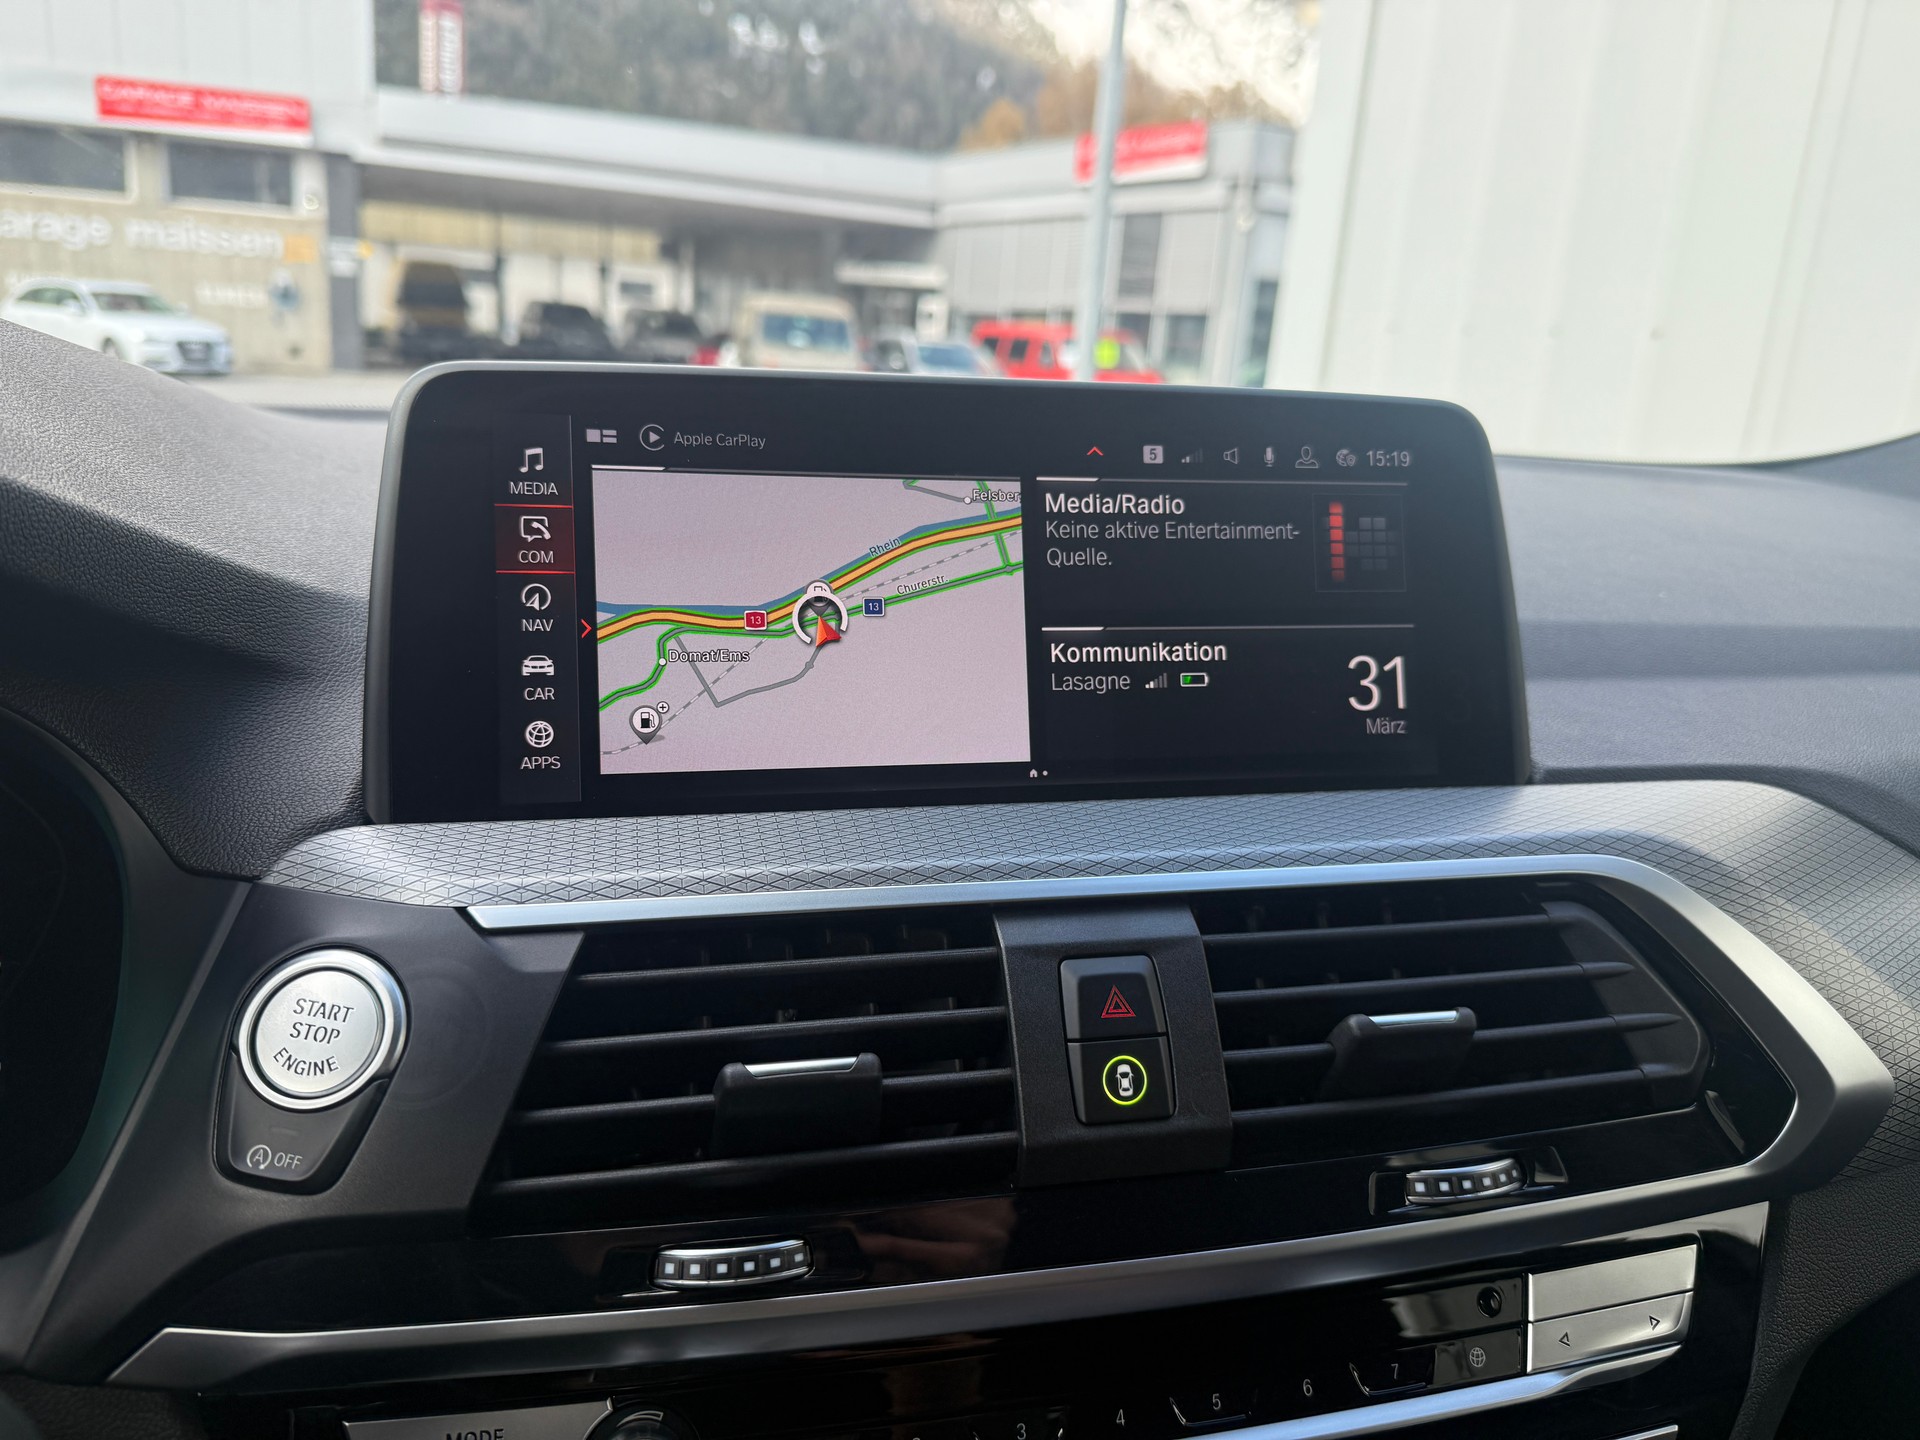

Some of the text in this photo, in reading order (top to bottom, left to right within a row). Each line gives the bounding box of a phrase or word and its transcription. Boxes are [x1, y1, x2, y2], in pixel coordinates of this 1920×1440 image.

[673, 431, 766, 450] Apple CarPlay
[1148, 447, 1158, 462] 5
[1366, 449, 1411, 468] 15:19
[509, 481, 559, 496] MEDIA
[972, 488, 1021, 503] Felsber
[1044, 492, 1186, 516] Media/Radio
[1044, 520, 1301, 541] Keine aktive Entertainment-
[869, 537, 901, 556] Rhein
[518, 550, 555, 565] COM
[1045, 547, 1114, 567] Quelle.
[896, 574, 948, 594] Churerstr.
[867, 601, 880, 612] 13
[521, 618, 554, 633] NAV
[749, 614, 762, 626] 13
[668, 648, 751, 664] Domat/Ems
[1049, 641, 1228, 663] Kommunikation
[1050, 671, 1131, 694] Lasagne
[1346, 654, 1408, 712] 31
[523, 686, 556, 701] CAR
[1365, 717, 1407, 735] März
[520, 756, 562, 770] APPS
[292, 998, 354, 1023] START
[289, 1021, 341, 1045] STOP
[272, 1047, 339, 1076] ENGINE
[274, 1151, 303, 1170] OFF
[1390, 1363, 1399, 1380] 7
[1302, 1378, 1313, 1397] 6
[1212, 1392, 1222, 1411] 5
[1115, 1408, 1126, 1427] 4
[1016, 1422, 1027, 1440] 3
